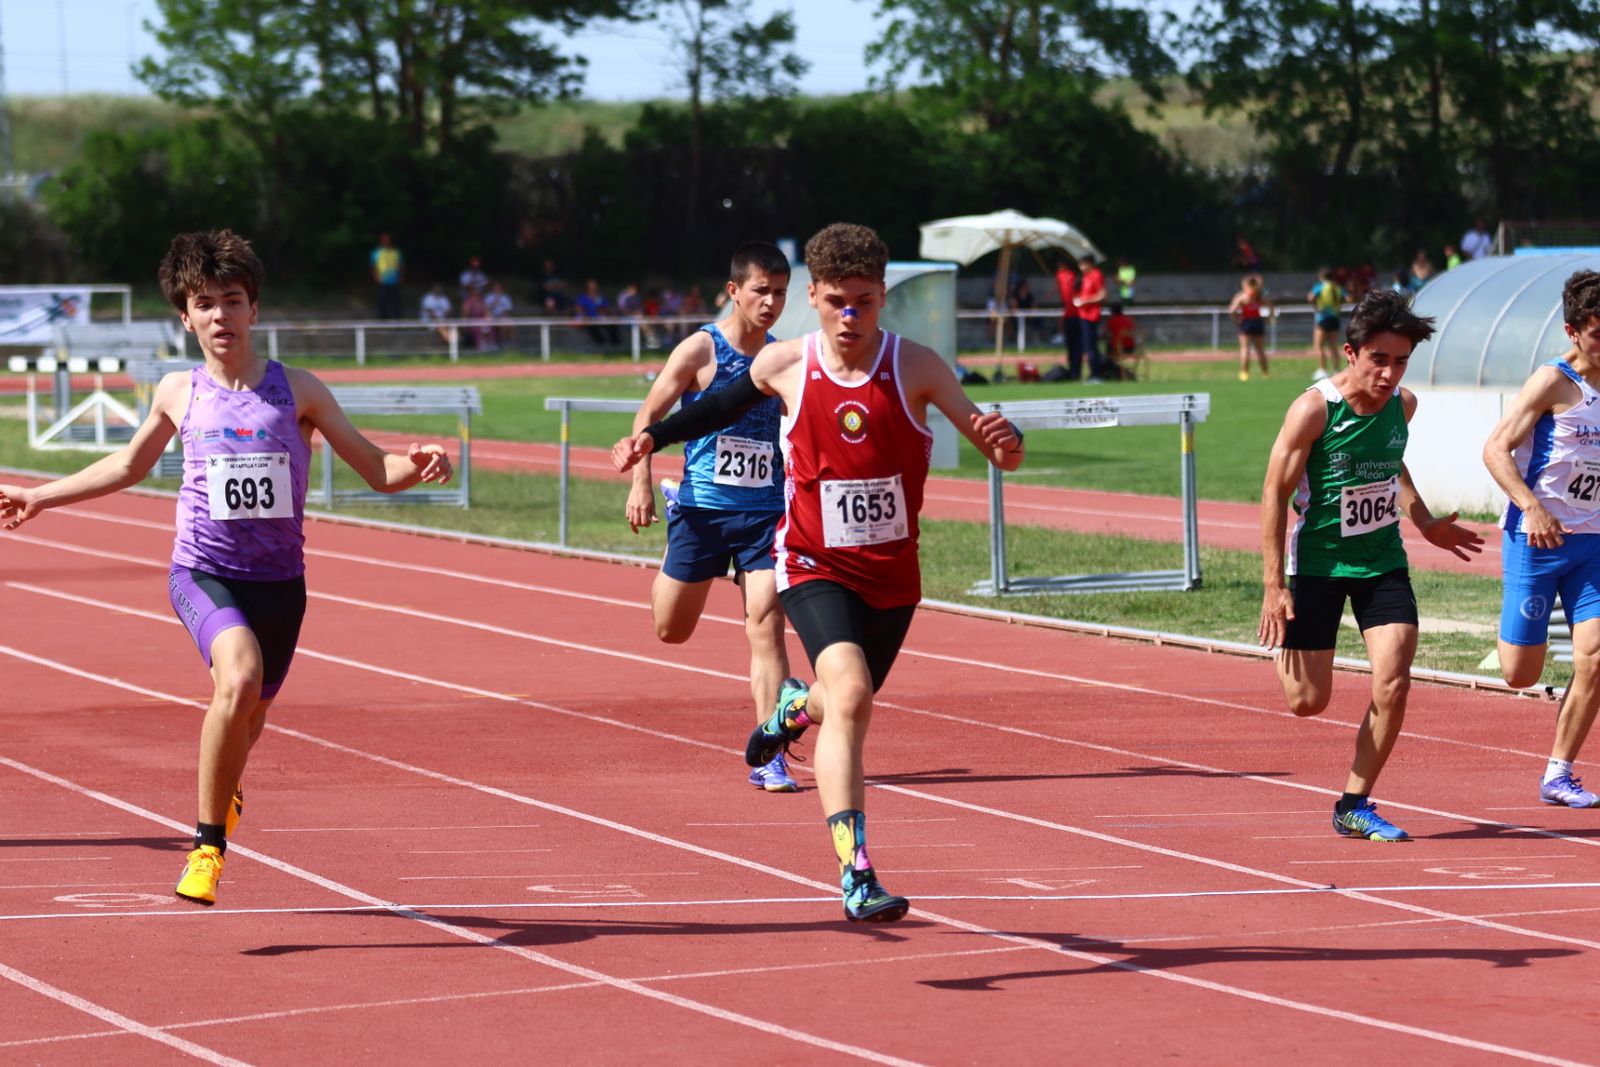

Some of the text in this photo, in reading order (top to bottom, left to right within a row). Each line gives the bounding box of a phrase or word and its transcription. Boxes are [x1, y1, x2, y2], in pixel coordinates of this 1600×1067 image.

[719, 450, 768, 480] 2316
[225, 477, 275, 510] 693
[837, 491, 897, 524] 1653
[1346, 491, 1397, 527] 3064
